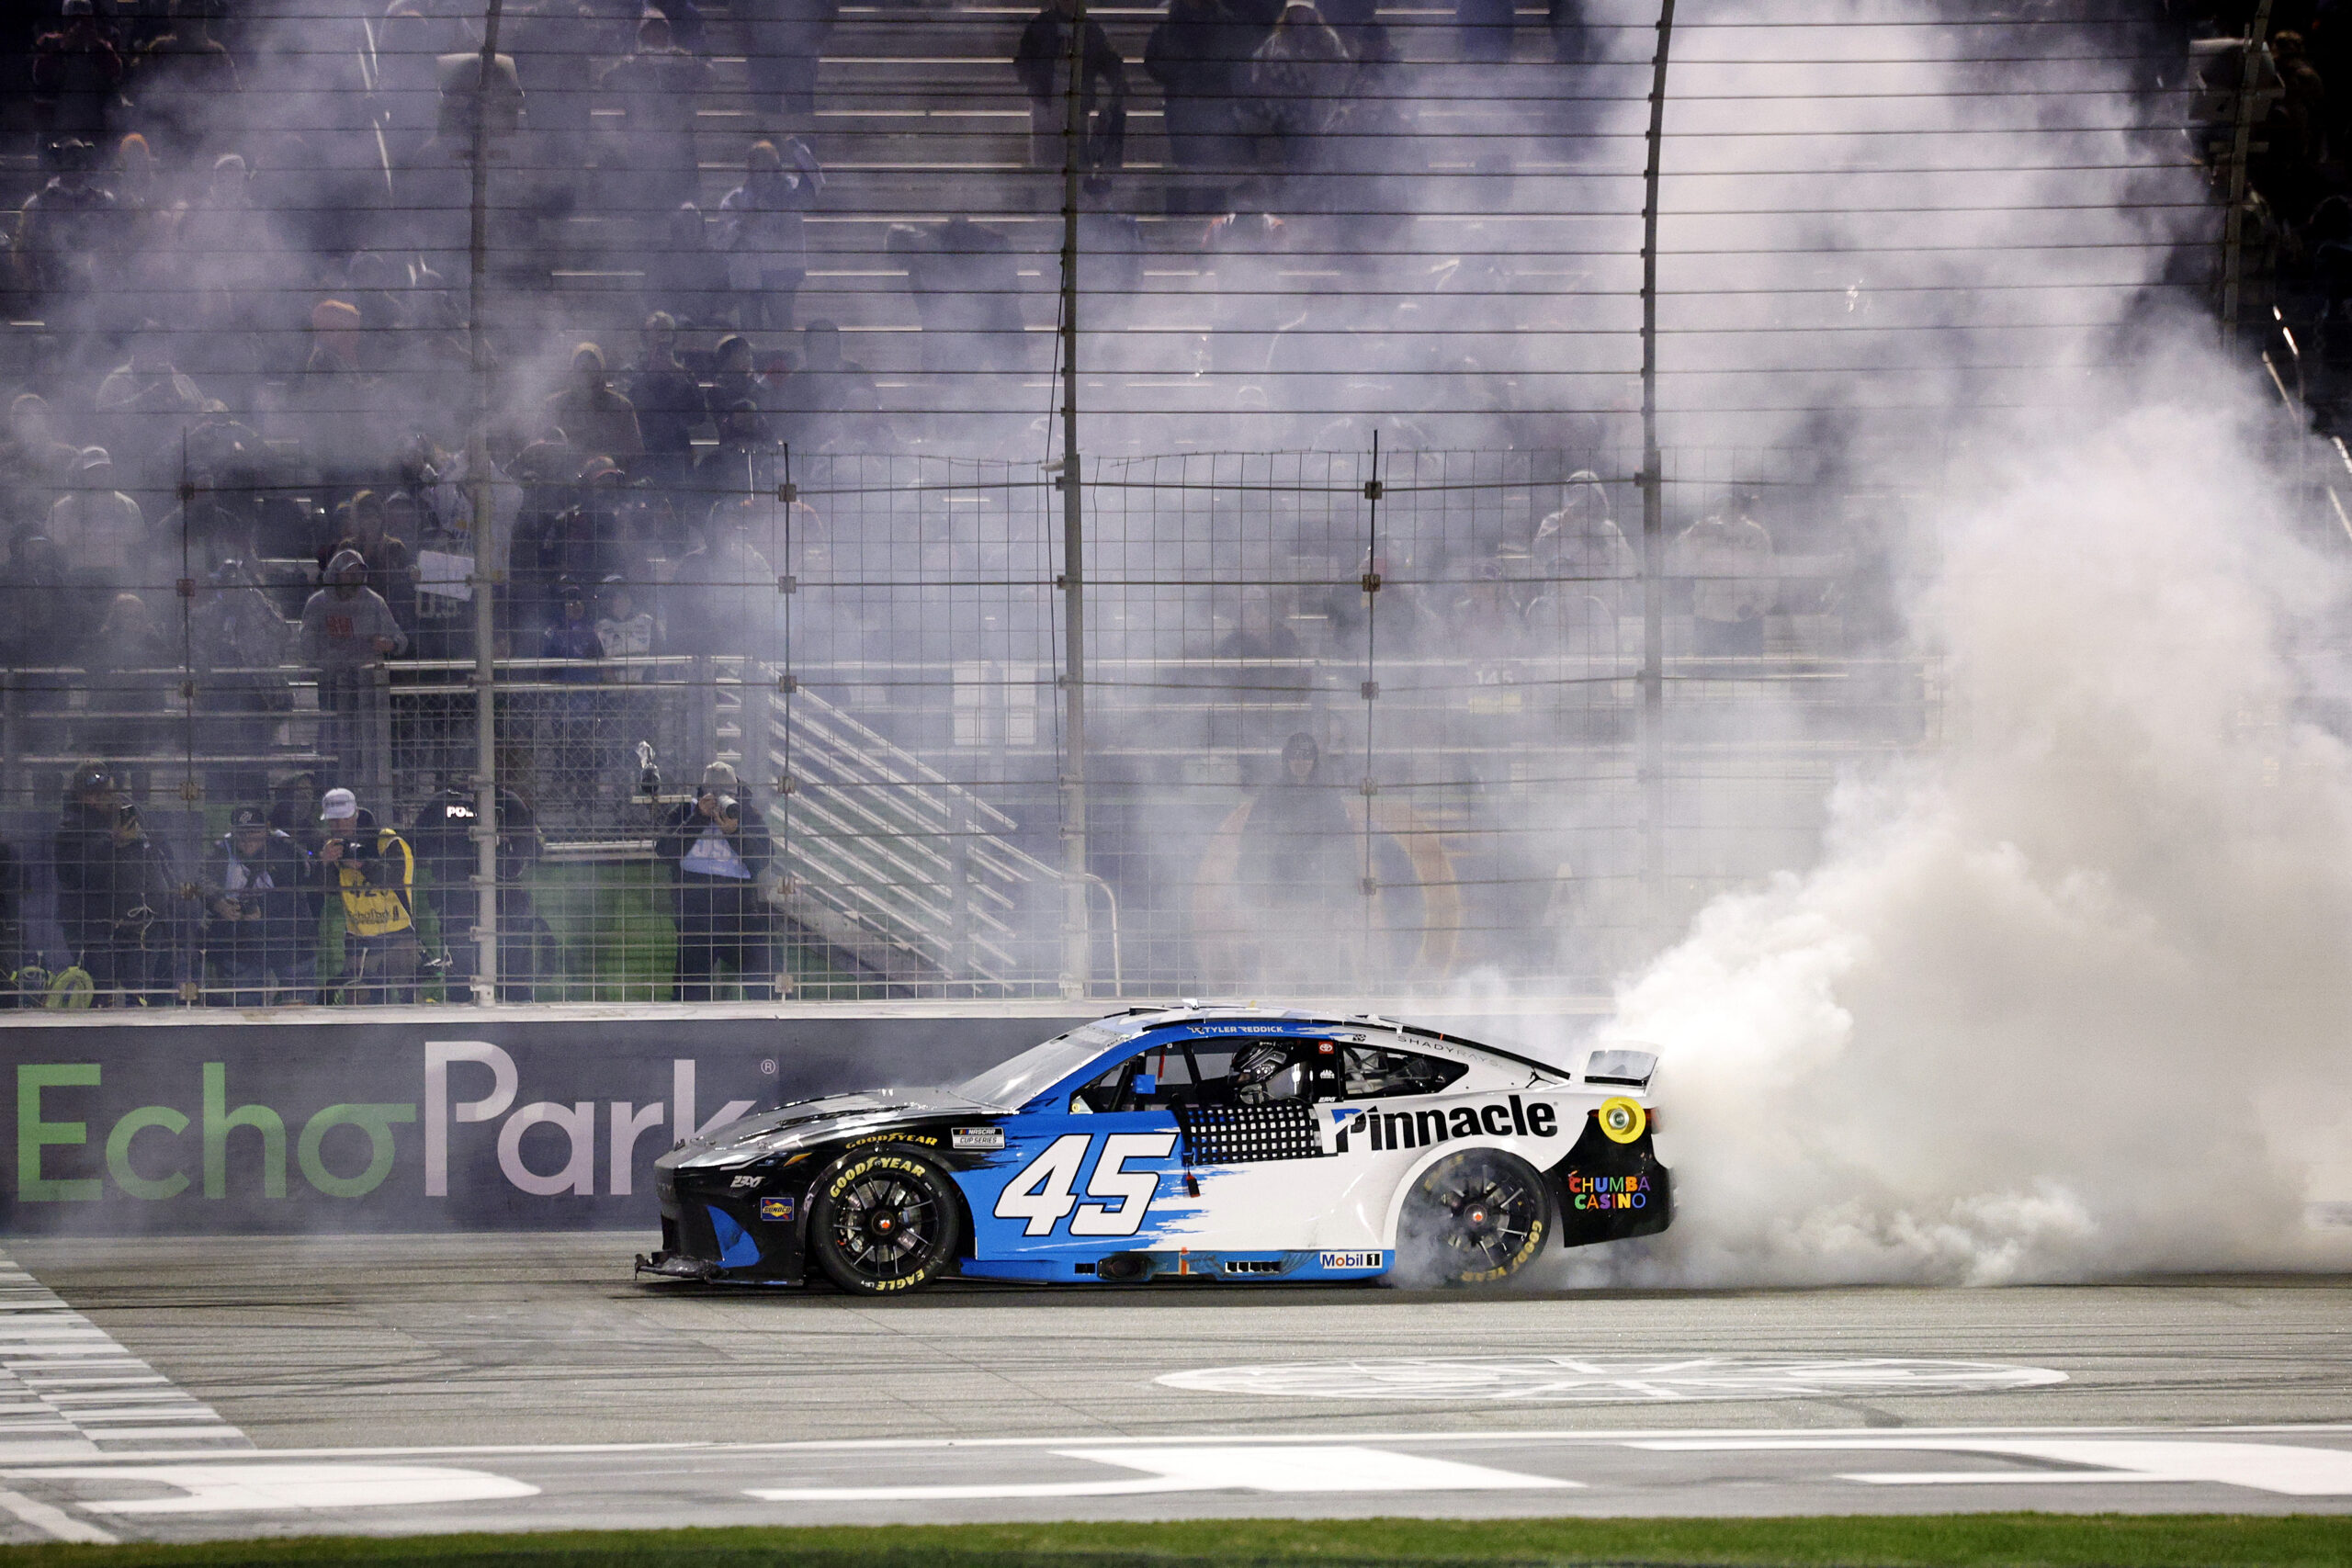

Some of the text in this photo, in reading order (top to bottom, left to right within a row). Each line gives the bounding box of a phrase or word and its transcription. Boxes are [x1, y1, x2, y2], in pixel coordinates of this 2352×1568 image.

[17, 1041, 757, 1201] EchoPark
[1330, 1094, 1558, 1153] Pinnacle
[844, 1132, 938, 1148] GOODYEAR
[830, 1156, 926, 1198] GOODYEAR
[993, 1133, 1180, 1236] 45
[1568, 1176, 1651, 1193] CHUMBA
[763, 1204, 792, 1214] SUNOCO
[1574, 1192, 1646, 1210] CASINO
[1323, 1254, 1363, 1267] Mobil
[876, 1268, 925, 1292] EAGLE
